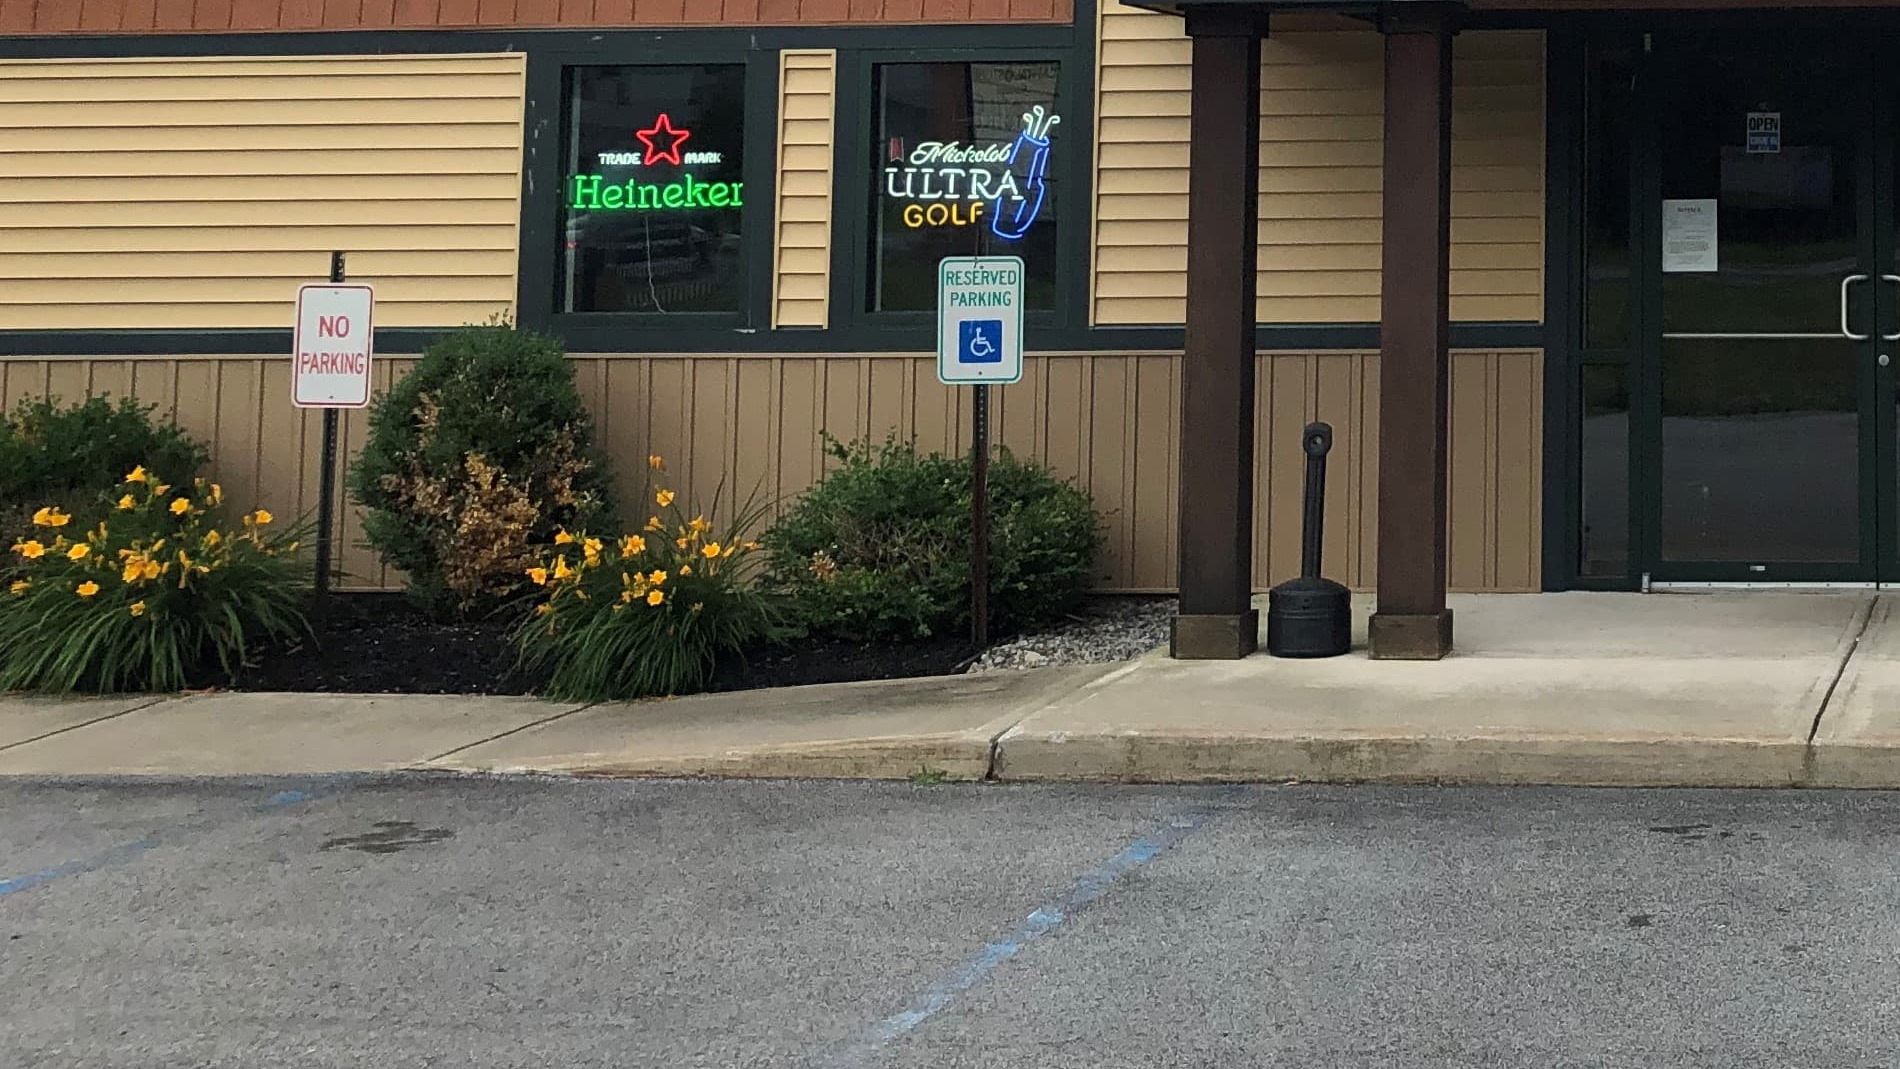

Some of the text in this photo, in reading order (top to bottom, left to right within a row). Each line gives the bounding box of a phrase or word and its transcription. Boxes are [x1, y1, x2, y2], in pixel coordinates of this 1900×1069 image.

[1749, 117, 1779, 131] OPEN
[598, 152, 722, 165] TRADE MARK
[885, 167, 1024, 200] ULTRA
[904, 202, 984, 228] GOLF
[946, 270, 1017, 286] RESERVED
[950, 291, 1011, 307] PARKING
[319, 316, 350, 338] NO
[300, 353, 365, 375] PARKING
